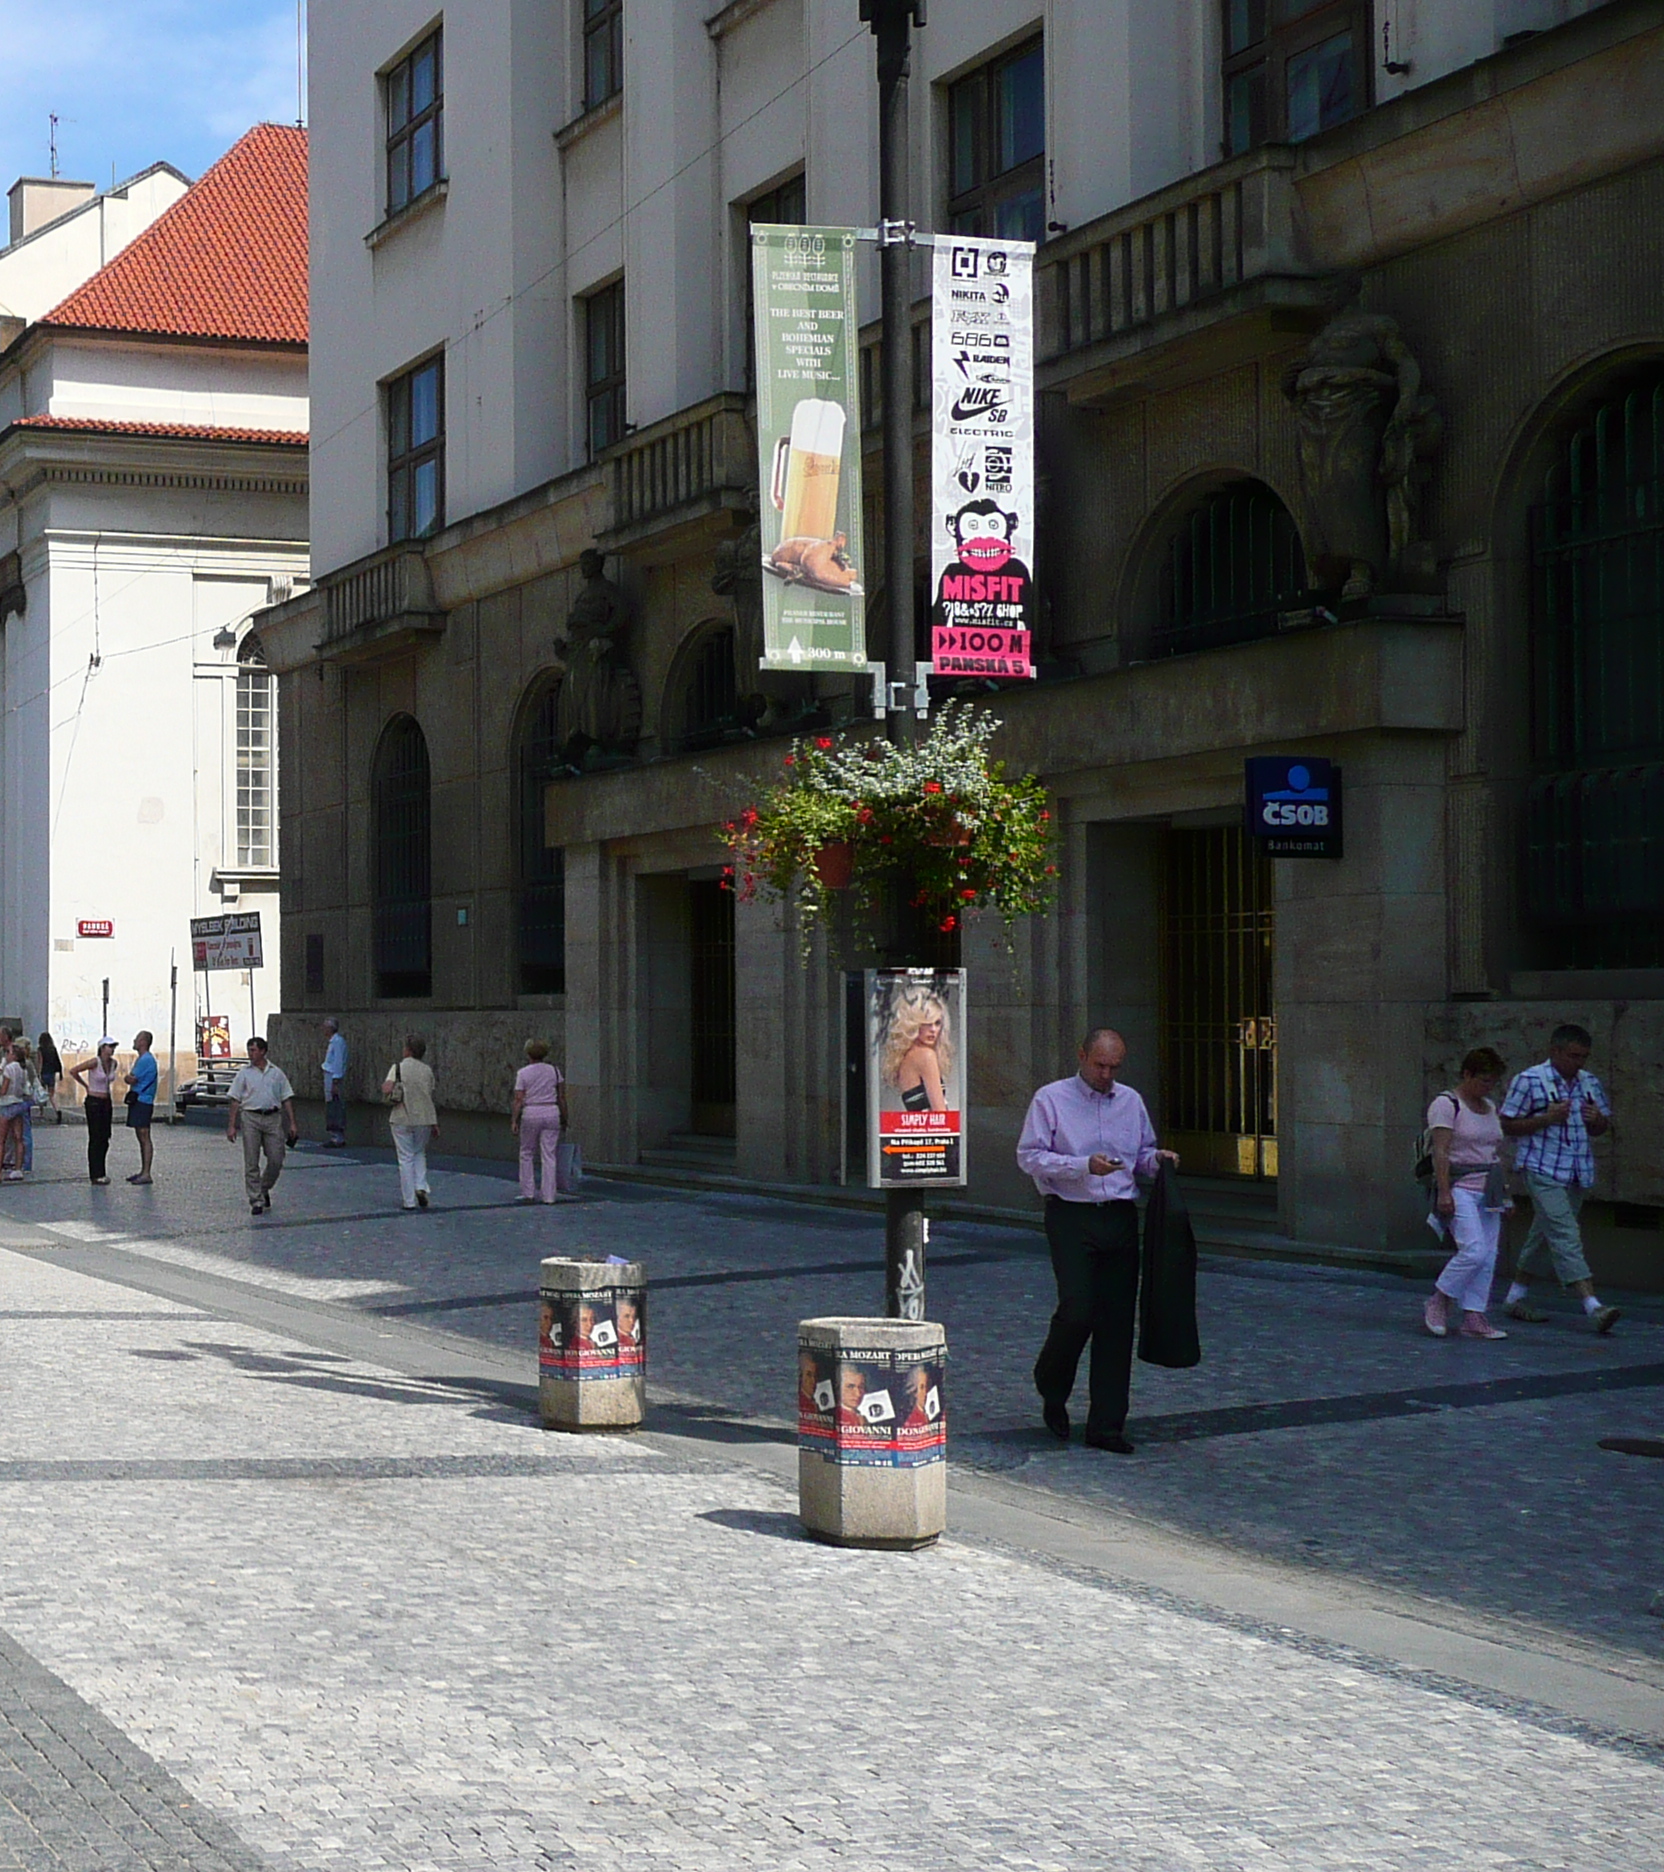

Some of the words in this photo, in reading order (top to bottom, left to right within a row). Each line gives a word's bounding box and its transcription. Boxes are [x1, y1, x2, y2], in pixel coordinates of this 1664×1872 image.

[951, 290, 986, 302] NIKITA
[770, 308, 790, 318] THE
[792, 309, 816, 319] BEST
[818, 310, 844, 320] BEER
[797, 321, 818, 331] AND
[782, 332, 835, 344] BOHEMIAN
[785, 345, 832, 355] SPECIALS
[796, 358, 822, 368] WITH
[972, 354, 1010, 369] RAIDEN
[777, 370, 800, 379] LIVE
[961, 387, 1001, 404] NIKE
[988, 408, 1008, 422] SB
[950, 427, 1014, 438] ELECTRIC
[986, 483, 1012, 493] NITRO
[942, 574, 1024, 602] MISFIT
[960, 632, 1004, 652] 100
[1009, 634, 1023, 653] M
[808, 647, 831, 659] 300
[834, 650, 846, 659] m
[938, 656, 1009, 674] PANSKÁ
[1012, 660, 1024, 674] 5
[1262, 801, 1329, 826] ČSOB
[1268, 840, 1324, 850] Bankomat
[901, 1114, 928, 1126] SIMPLY
[929, 1114, 946, 1126] HAIR
[850, 1350, 892, 1360] MOZART
[841, 1425, 892, 1436] GIOVANNI
[896, 1427, 918, 1436] DON
